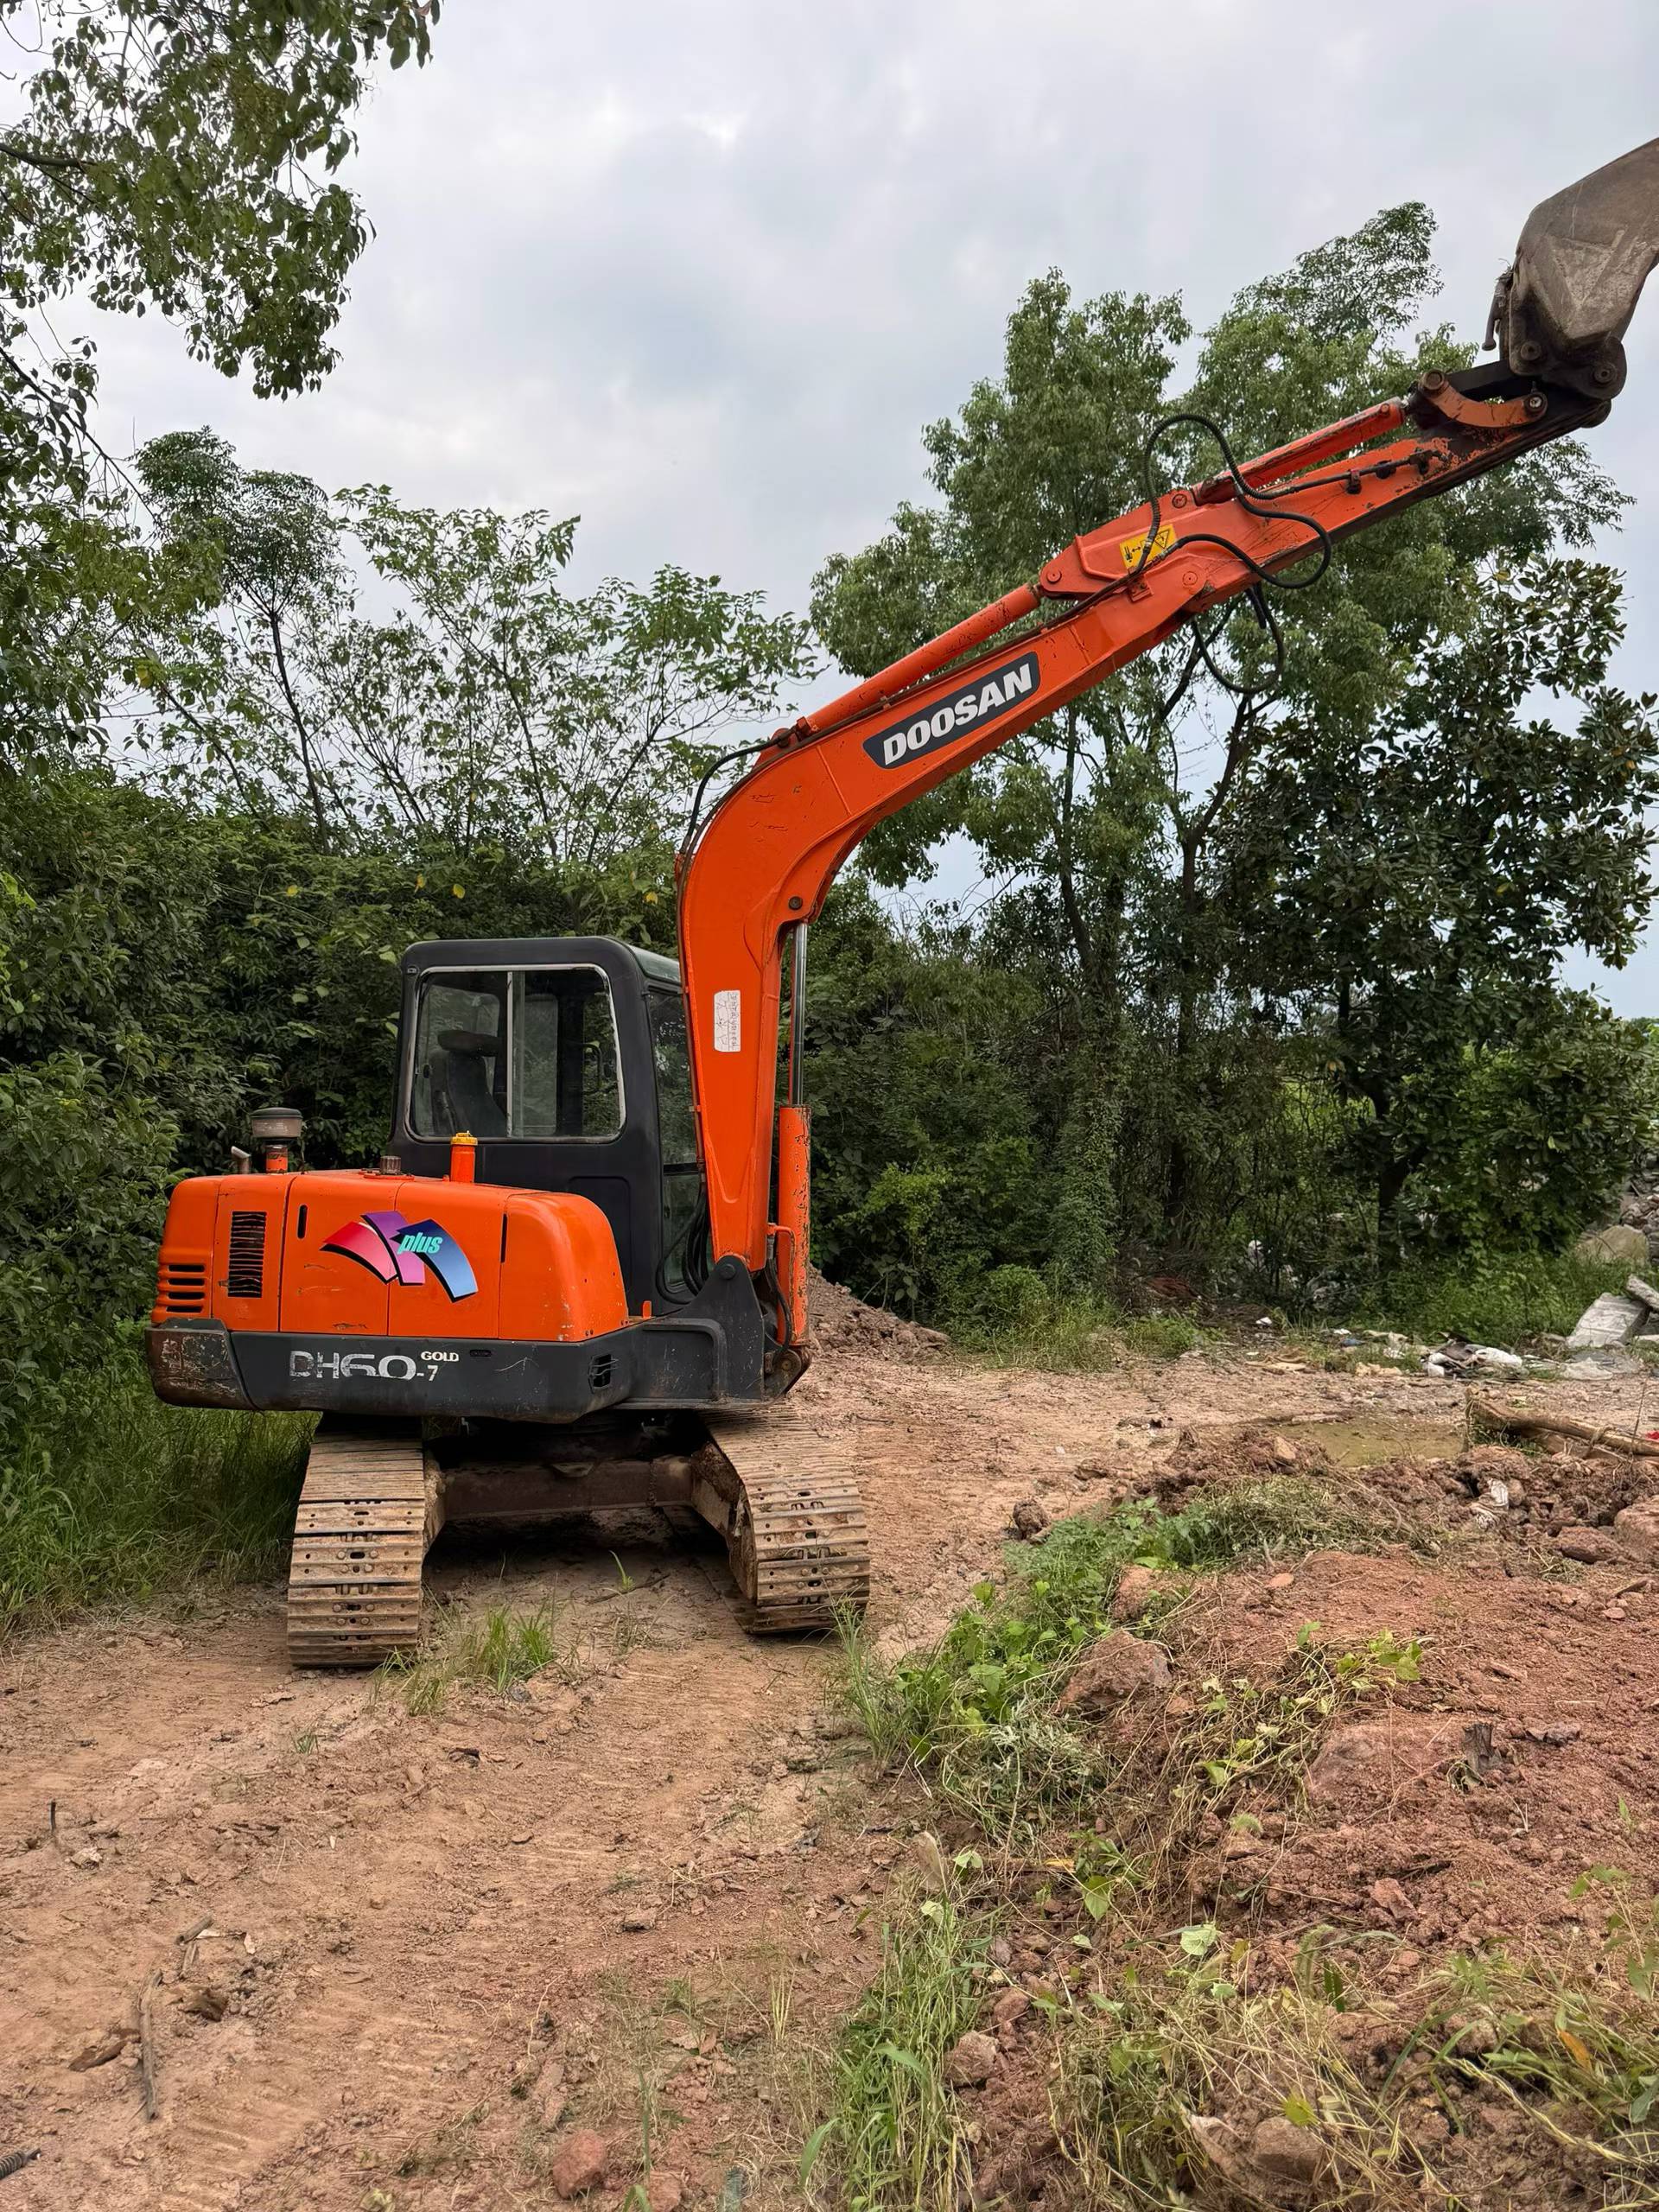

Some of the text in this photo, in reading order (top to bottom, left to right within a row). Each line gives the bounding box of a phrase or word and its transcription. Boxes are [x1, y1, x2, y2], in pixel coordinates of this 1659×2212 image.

[883, 663, 1033, 766] DOOSAN
[397, 1232, 443, 1254] plus
[420, 1351, 460, 1362] GOLD
